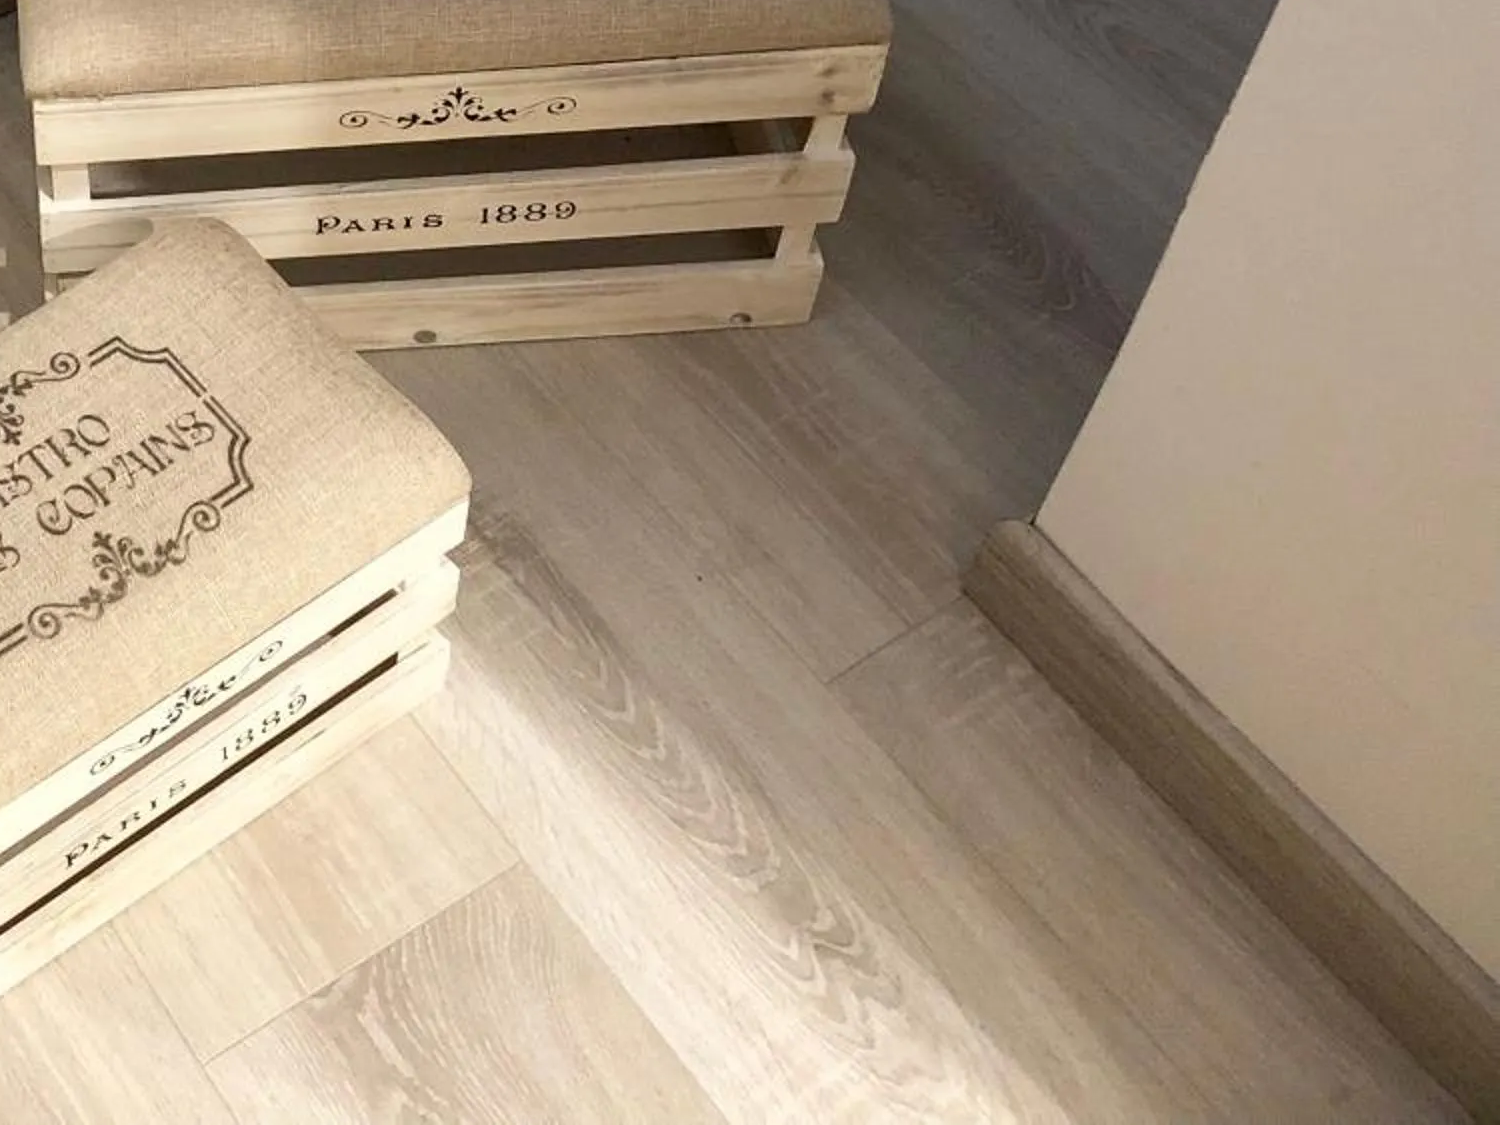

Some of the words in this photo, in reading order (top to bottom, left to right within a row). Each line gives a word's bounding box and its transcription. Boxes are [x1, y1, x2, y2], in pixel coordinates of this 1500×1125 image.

[479, 200, 578, 227] 1889
[36, 409, 215, 535] COPAINS
[220, 693, 308, 763] 1889
